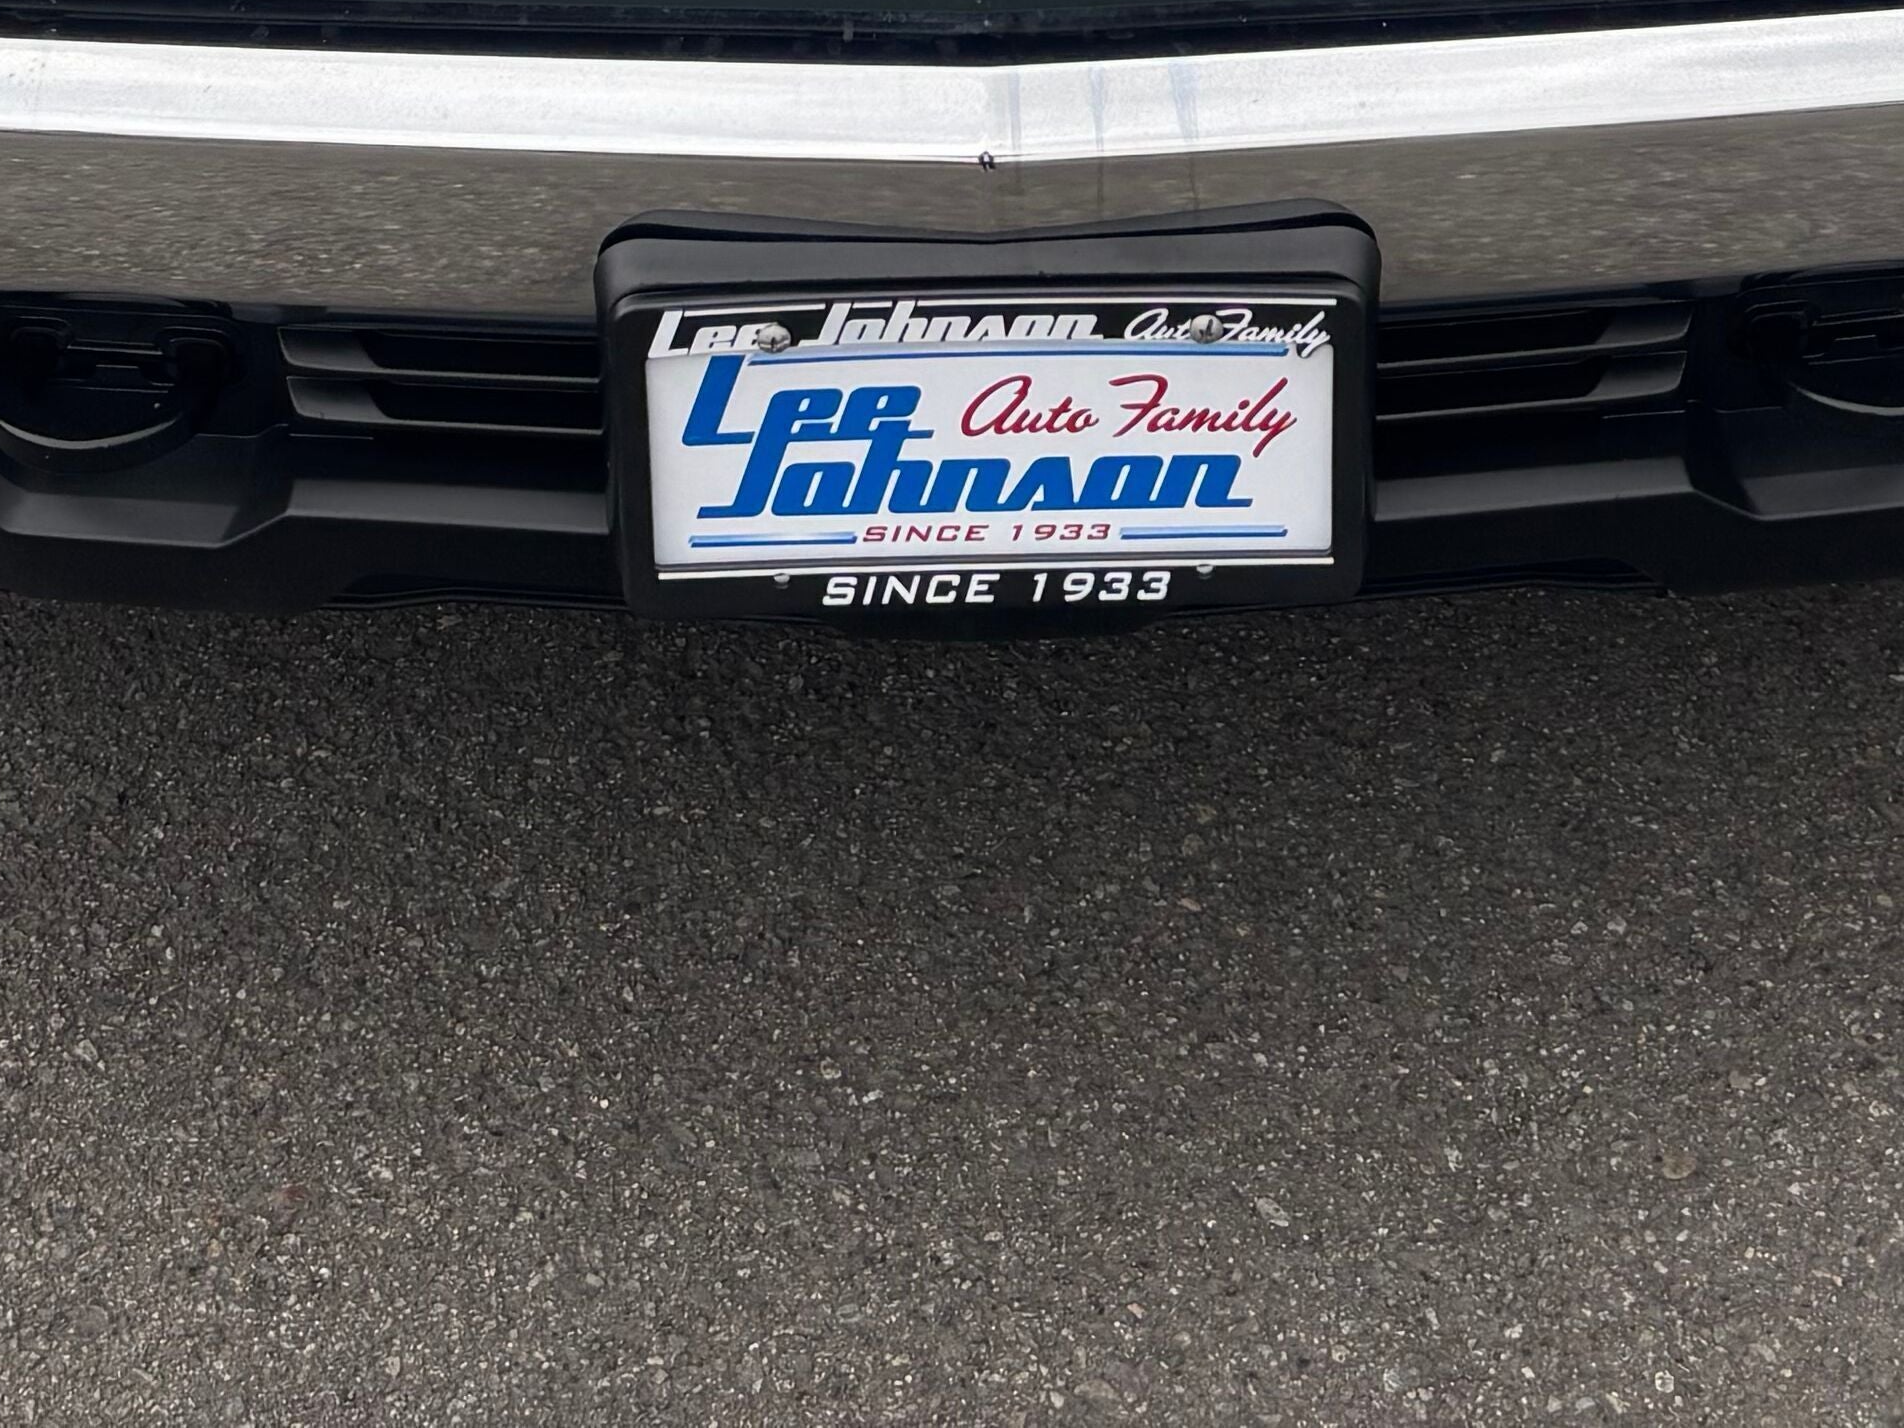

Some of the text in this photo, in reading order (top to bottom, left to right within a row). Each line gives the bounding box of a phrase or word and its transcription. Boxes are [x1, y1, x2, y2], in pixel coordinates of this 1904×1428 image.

[798, 300, 1104, 348] Johnson
[1124, 308, 1193, 341] Aut
[1215, 308, 1331, 358] Family
[681, 355, 1297, 458] Lee Auto Family
[697, 429, 1253, 518] Johnson
[862, 523, 1112, 543] SINCE 1933
[821, 569, 1172, 607] SINCE 1933
